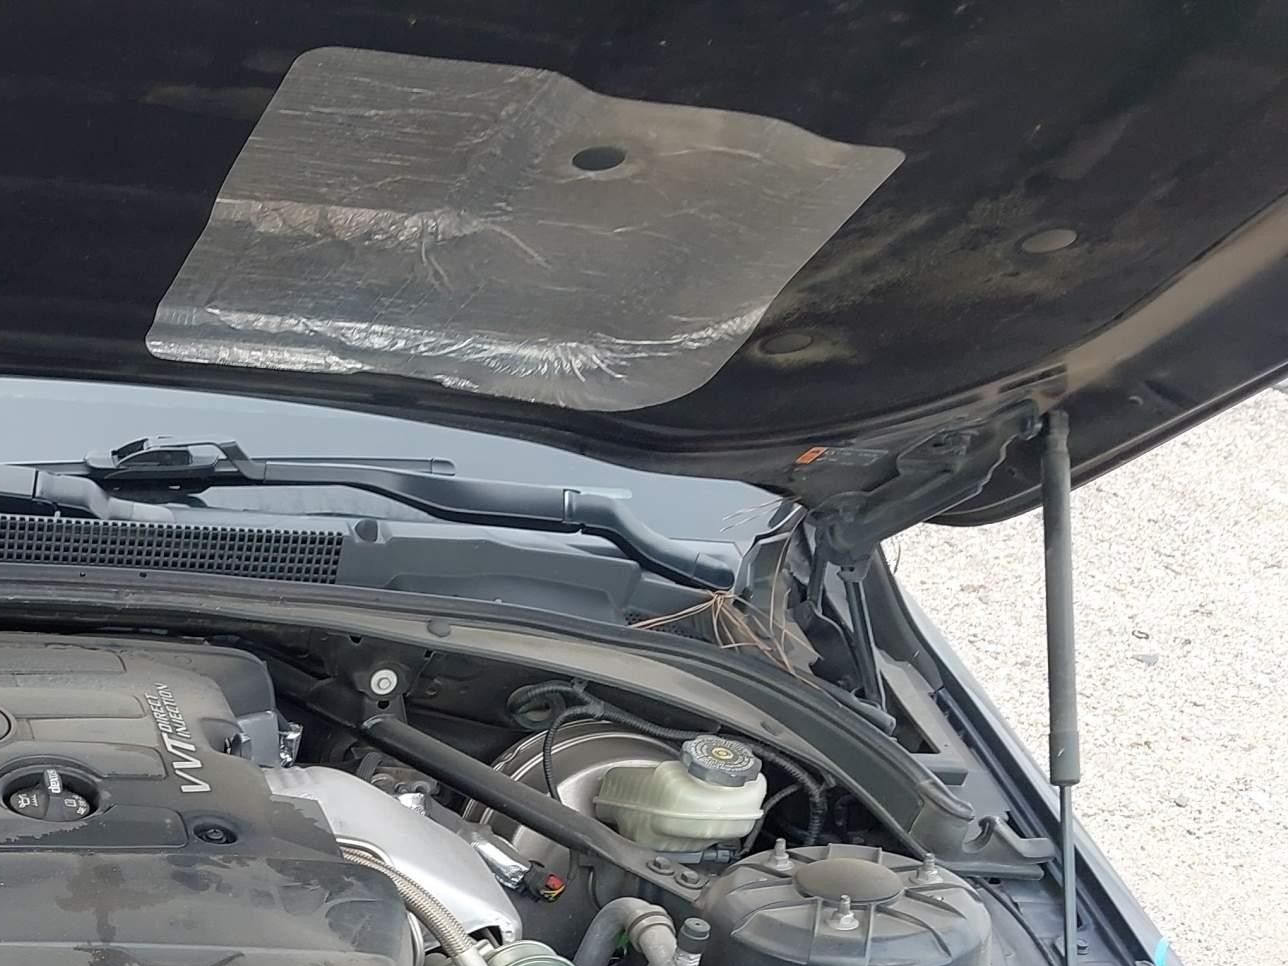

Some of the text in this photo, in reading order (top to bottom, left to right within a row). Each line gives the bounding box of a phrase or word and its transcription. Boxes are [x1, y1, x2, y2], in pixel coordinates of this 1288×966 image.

[144, 692, 173, 733] DIRECT
[153, 682, 191, 738] INJECTION
[161, 732, 211, 792] VVT
